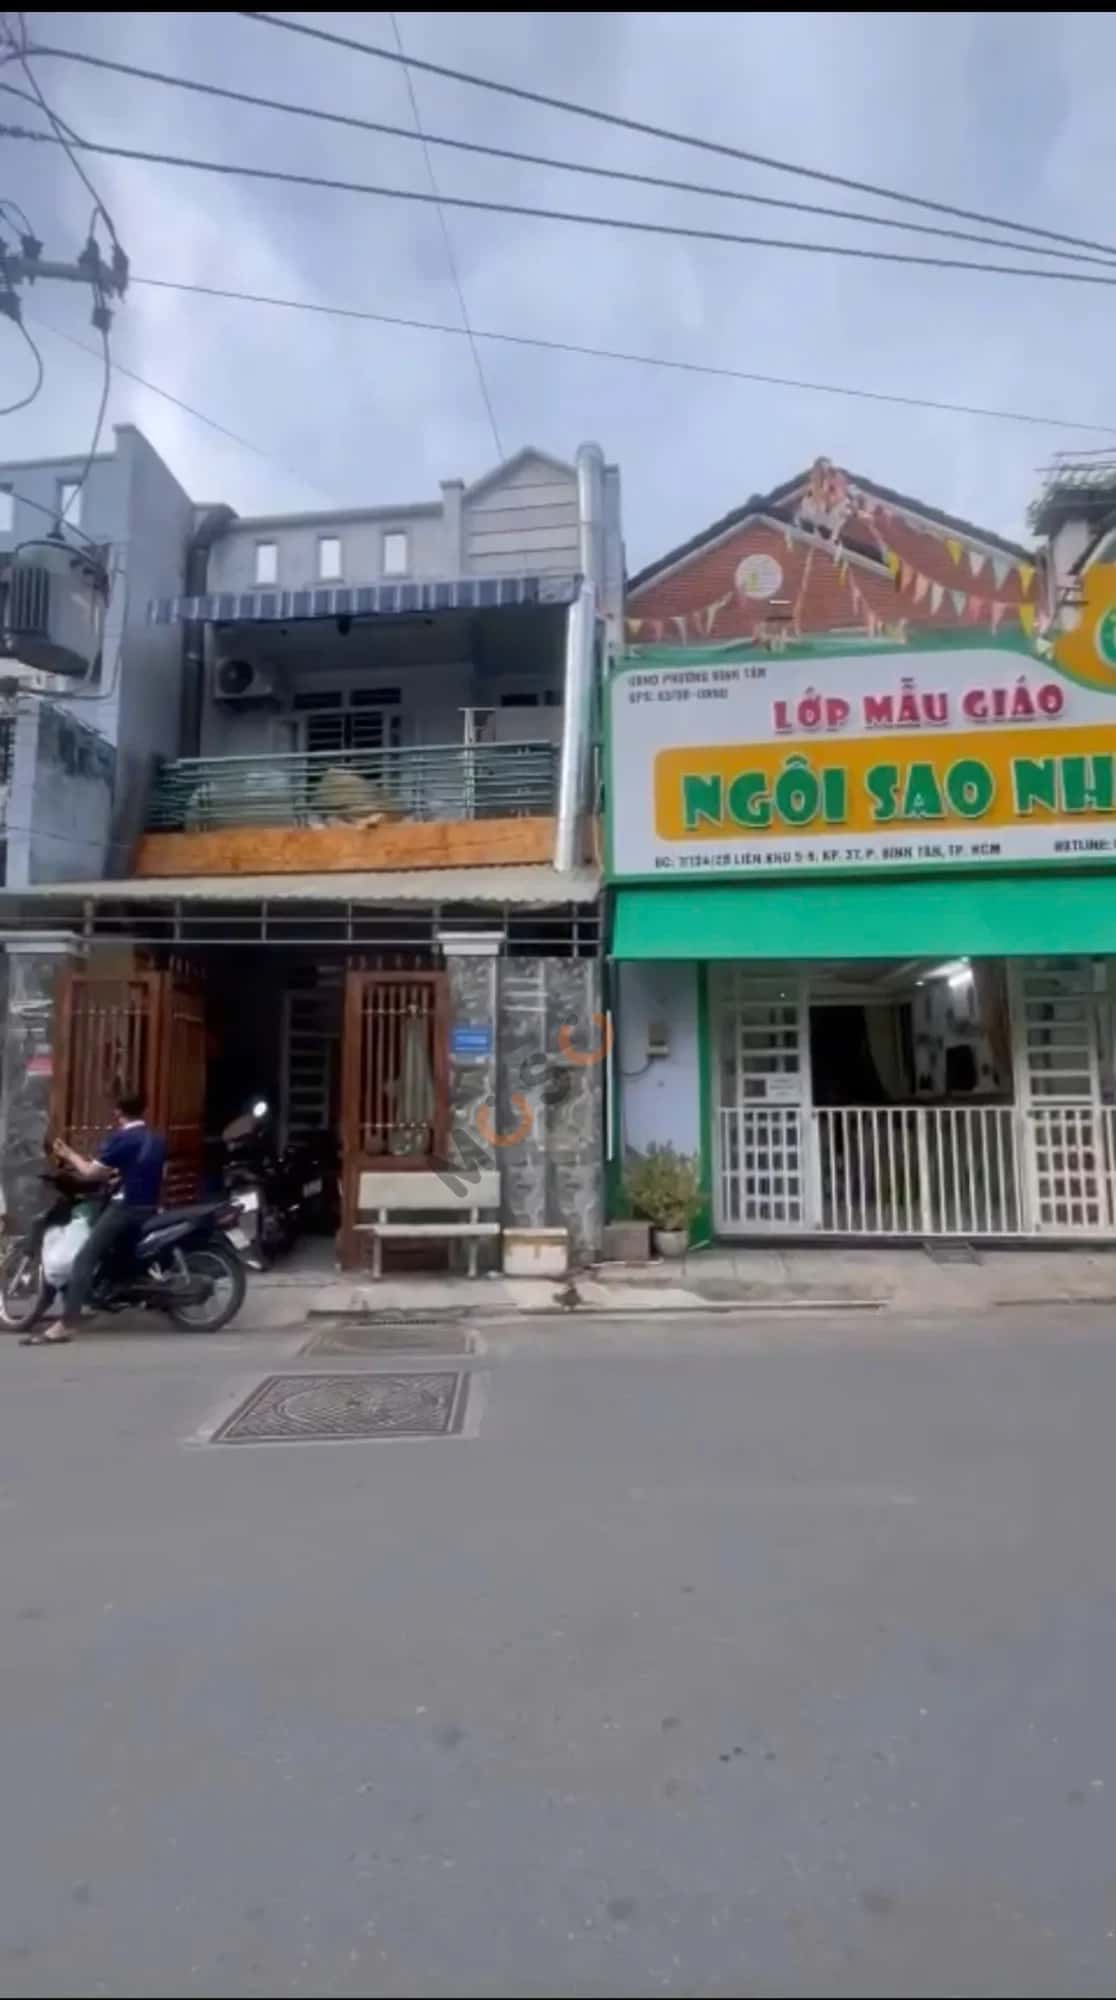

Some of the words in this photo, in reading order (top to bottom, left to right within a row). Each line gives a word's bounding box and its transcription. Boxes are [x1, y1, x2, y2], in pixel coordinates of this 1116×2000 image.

[773, 686, 850, 730] LỚP
[863, 677, 948, 726] MẪU
[961, 675, 1065, 720] GIÁO
[681, 753, 847, 829] NGÔI
[865, 757, 995, 821] SAO
